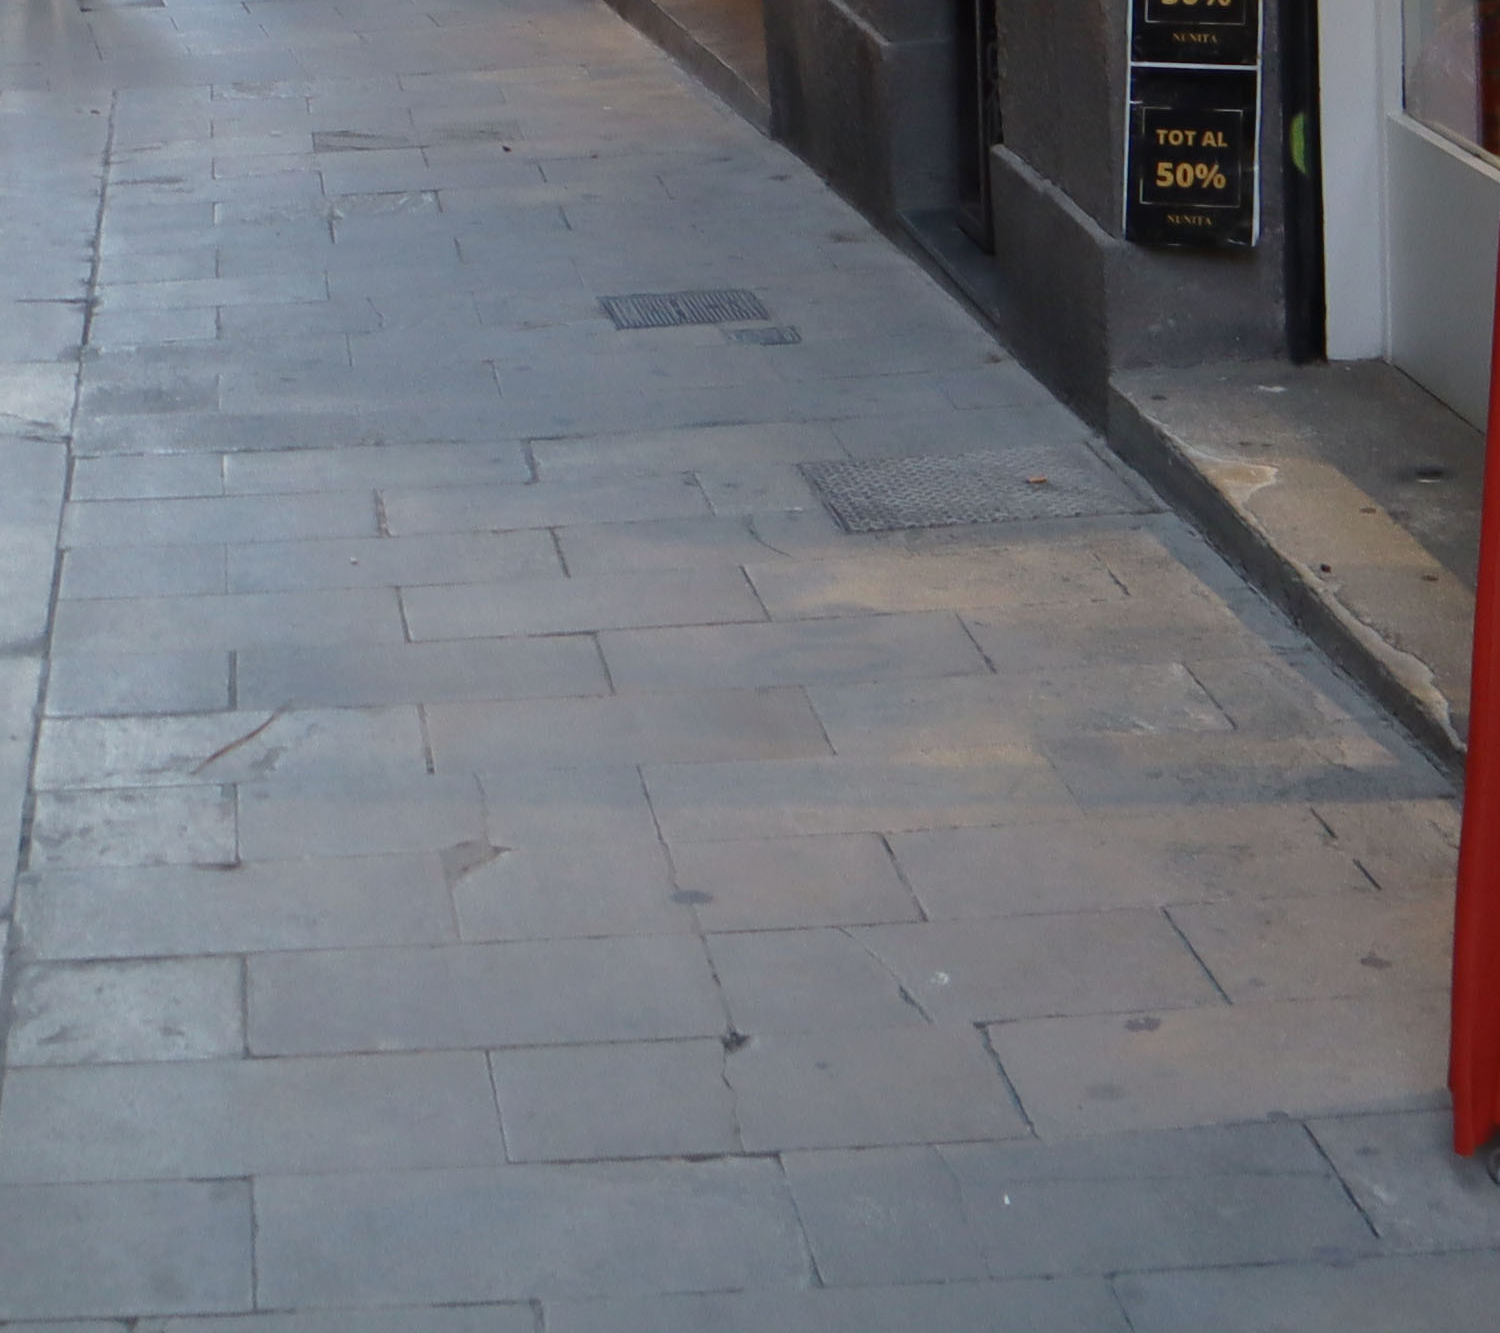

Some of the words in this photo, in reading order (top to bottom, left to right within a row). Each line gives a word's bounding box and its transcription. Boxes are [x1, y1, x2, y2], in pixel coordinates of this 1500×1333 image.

[1172, 33, 1218, 44] NUNITA
[1156, 129, 1196, 146] TOT
[1202, 131, 1228, 148] AL
[1155, 161, 1226, 189] 50%
[1167, 214, 1213, 226] NUNITA
